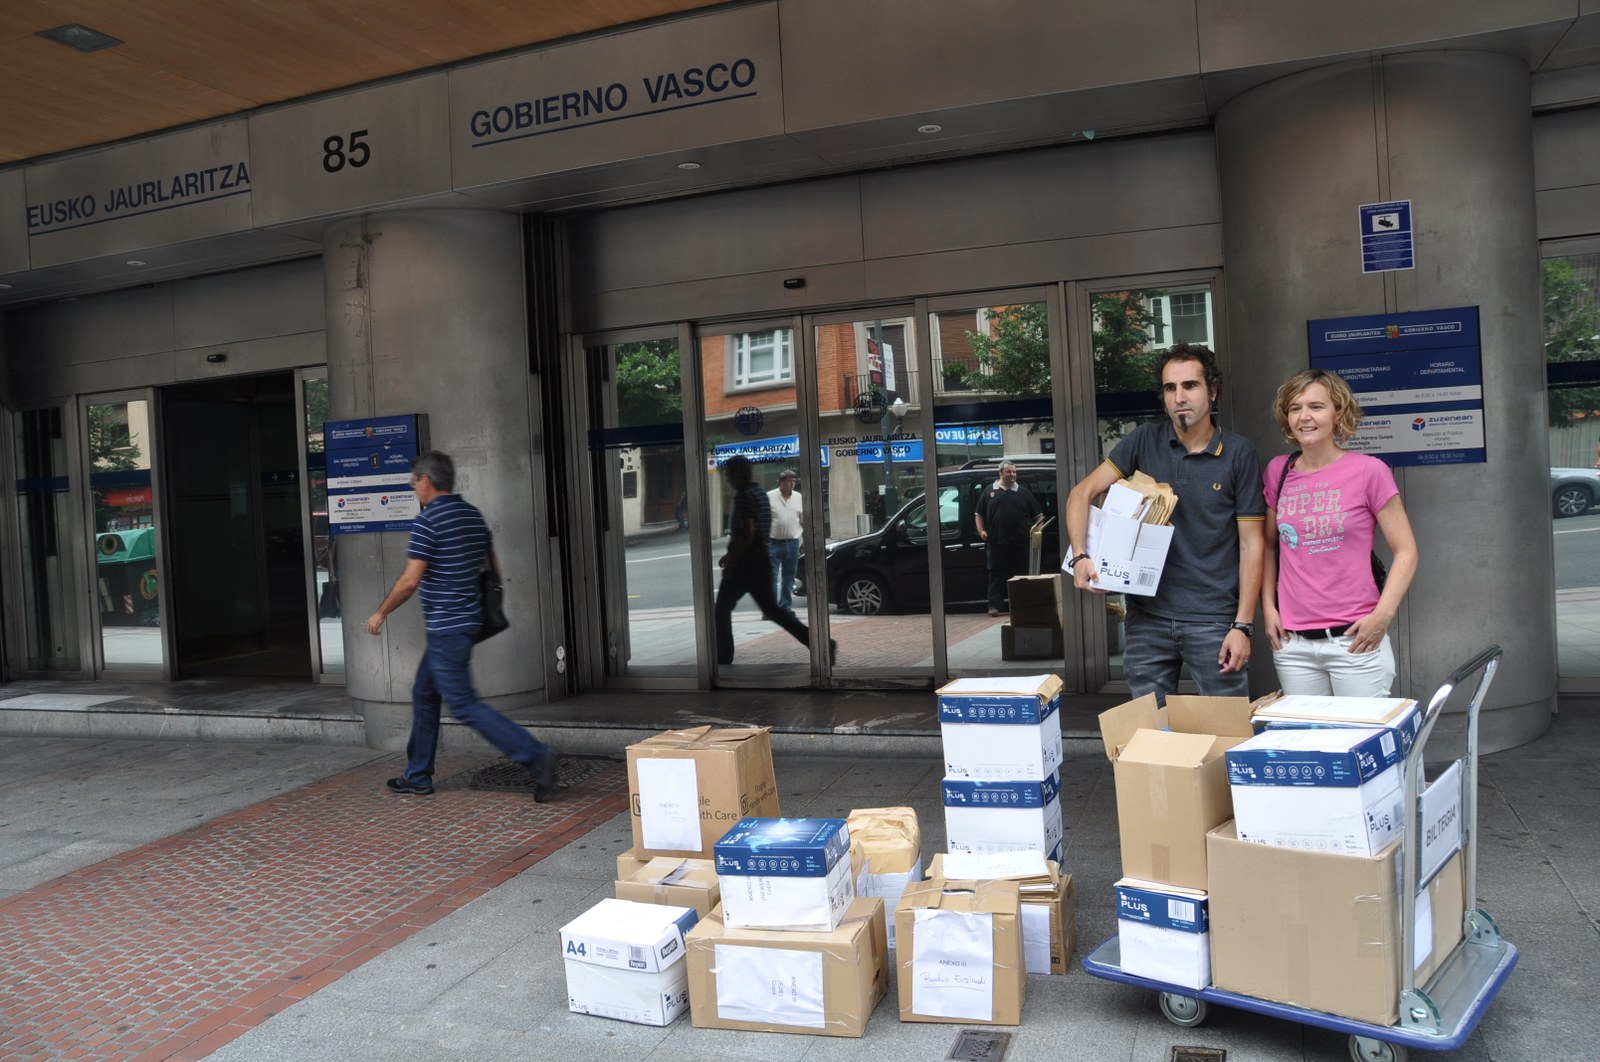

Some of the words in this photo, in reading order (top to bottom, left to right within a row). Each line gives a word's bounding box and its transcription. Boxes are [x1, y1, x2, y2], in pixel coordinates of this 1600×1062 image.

[470, 83, 628, 138] GOBIERNO
[643, 58, 756, 104] VASCO
[323, 130, 371, 173] 85
[27, 195, 95, 228] EUSKO
[105, 162, 250, 212] JAURLARITZA
[1420, 367, 1465, 375] DEPARTAMENTAL
[1428, 414, 1473, 422] zuzenean
[829, 436, 857, 445] EUSKO
[859, 433, 917, 443] JAURLARITZA
[710, 446, 737, 455] EUSKO
[738, 443, 792, 454] JAURLARITZA
[835, 447, 880, 458] GOBIERNO
[882, 446, 911, 455] VASCO
[1277, 489, 1342, 521] SUPER
[1302, 511, 1349, 540] DRY
[1100, 567, 1130, 580] PLUS
[1360, 756, 1375, 770] PLUS
[1232, 767, 1254, 775] PLUS
[700, 810, 713, 820] ith
[714, 810, 738, 821] Care
[1370, 813, 1390, 835] PLUS
[1426, 804, 1457, 848] BILTEGIA
[1121, 901, 1148, 912] PLUS
[566, 940, 587, 957] A4
[630, 961, 646, 969] Report
[939, 959, 961, 967] ANEXO
[571, 1002, 588, 1011] PLUS
[667, 990, 687, 1011] PLUS
